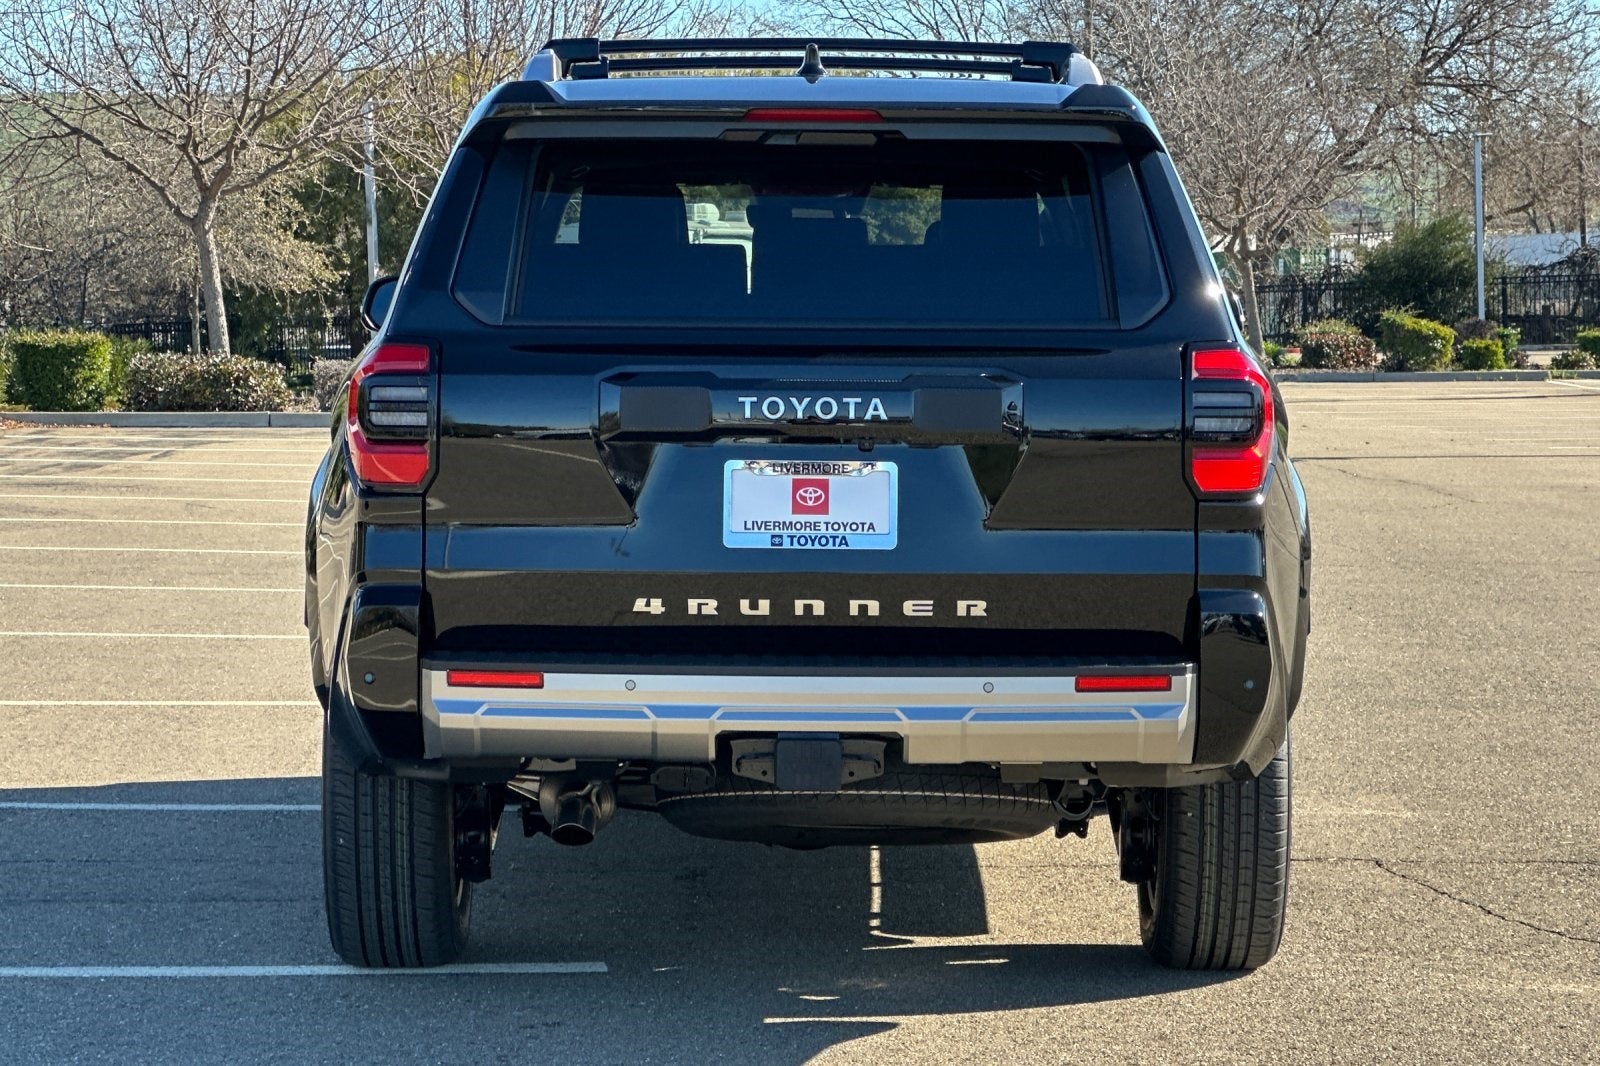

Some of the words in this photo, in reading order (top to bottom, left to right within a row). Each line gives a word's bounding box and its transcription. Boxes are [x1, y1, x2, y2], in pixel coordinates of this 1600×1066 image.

[738, 396, 888, 421] TOYOTA
[772, 463, 849, 475] LIVERMORE
[744, 520, 820, 532] LIVERMORE
[823, 521, 876, 532] TOYOTA
[787, 535, 849, 547] TOYOTA
[632, 598, 988, 617] 4RUNNER
